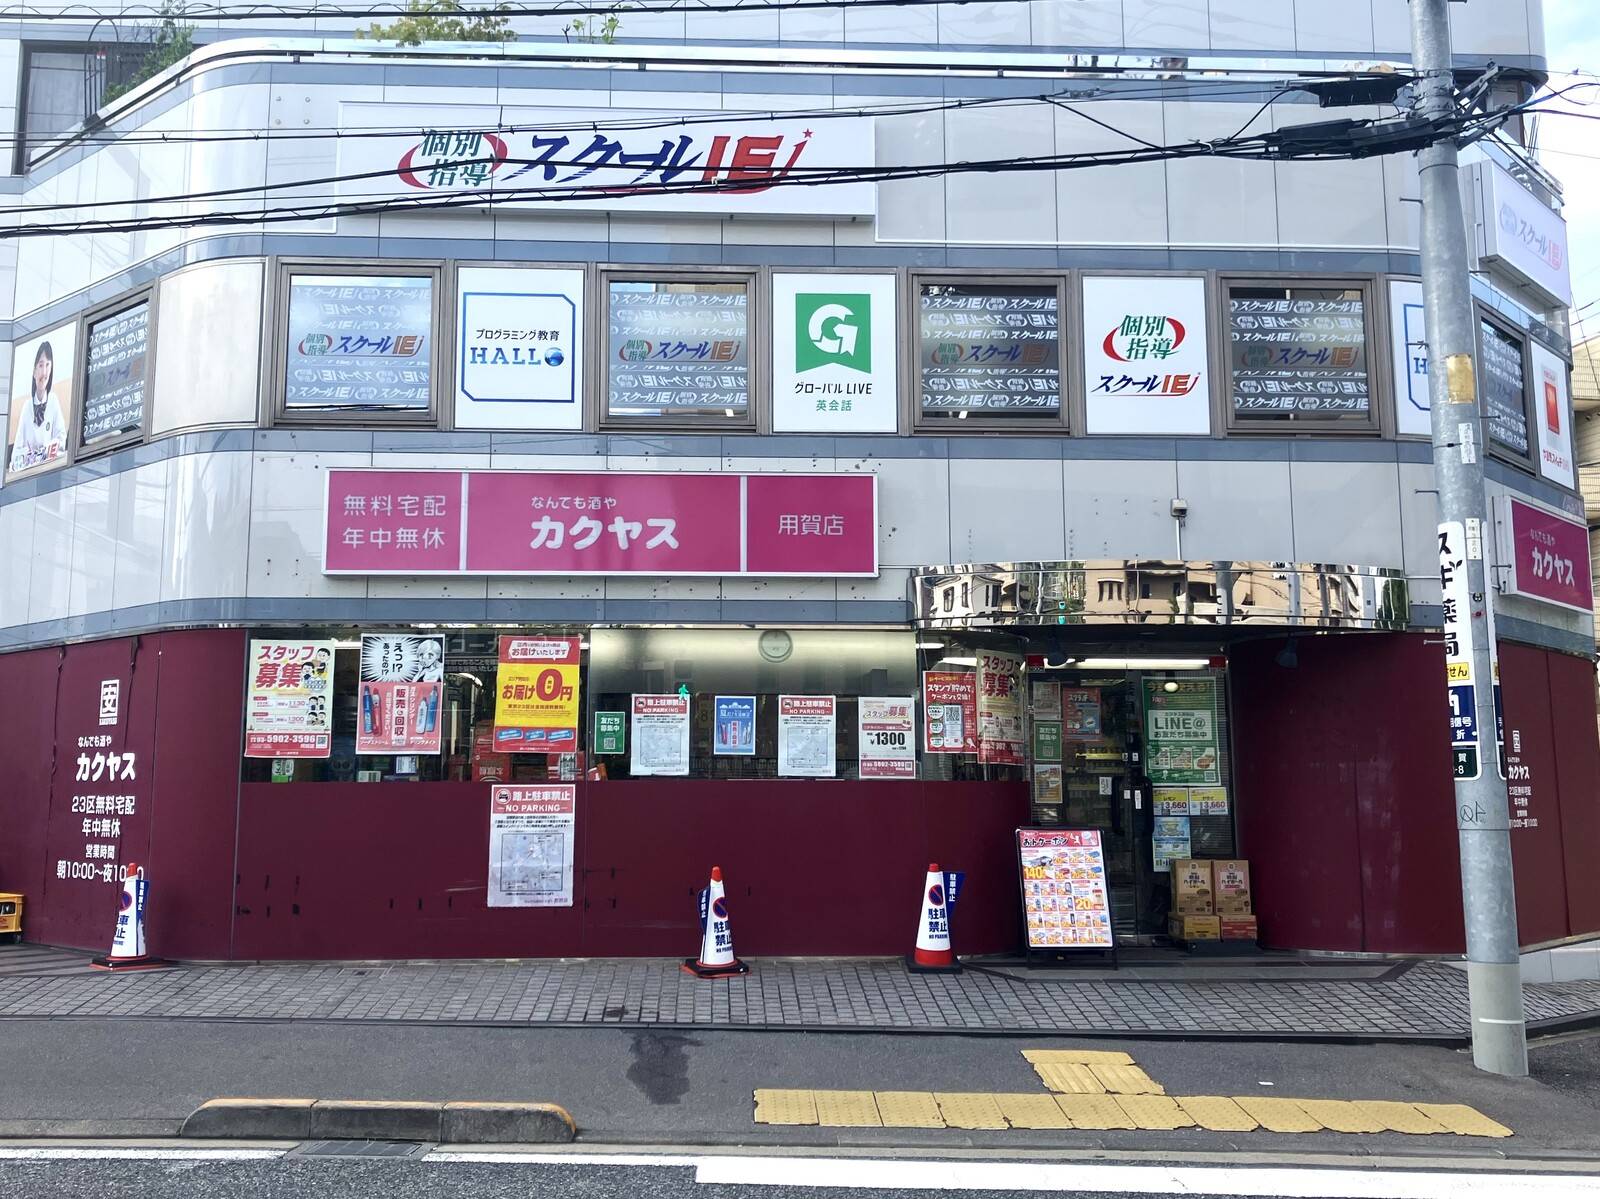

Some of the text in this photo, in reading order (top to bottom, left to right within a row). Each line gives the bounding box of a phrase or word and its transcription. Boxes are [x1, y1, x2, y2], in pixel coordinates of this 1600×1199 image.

[421, 130, 481, 157] 個別
[429, 159, 491, 187] 指導
[476, 328, 560, 341] プログラミング教育
[1120, 315, 1165, 337] 個別
[1126, 338, 1174, 361] 指導
[846, 382, 873, 395] LIVE
[815, 399, 853, 412] 英会話
[344, 494, 446, 517] 無料宅配
[531, 496, 617, 510] なんでも酒や
[530, 515, 680, 550] カクヤス
[779, 514, 845, 536] 用賀店
[342, 526, 446, 550] 年中無休
[1531, 546, 1576, 587] カクヤス
[258, 645, 315, 661] スタッフ
[512, 648, 567, 657] お届けいたします
[982, 655, 1015, 672] スタッフ
[255, 663, 303, 688] 募集
[984, 672, 1010, 698] 募集
[1154, 717, 1206, 731] LINE@
[78, 735, 112, 748] なんでも酒や
[1456, 729, 1466, 740] 折
[75, 751, 136, 782] カクヤス
[1508, 765, 1531, 780] カクヤス
[512, 791, 571, 802] 路上駐車禁止
[71, 795, 136, 816] 23区無料宅配
[505, 804, 561, 812] NO PARKING
[81, 817, 121, 838] 年中無休
[85, 844, 115, 860] 営業時間
[928, 921, 947, 933] 禁止
